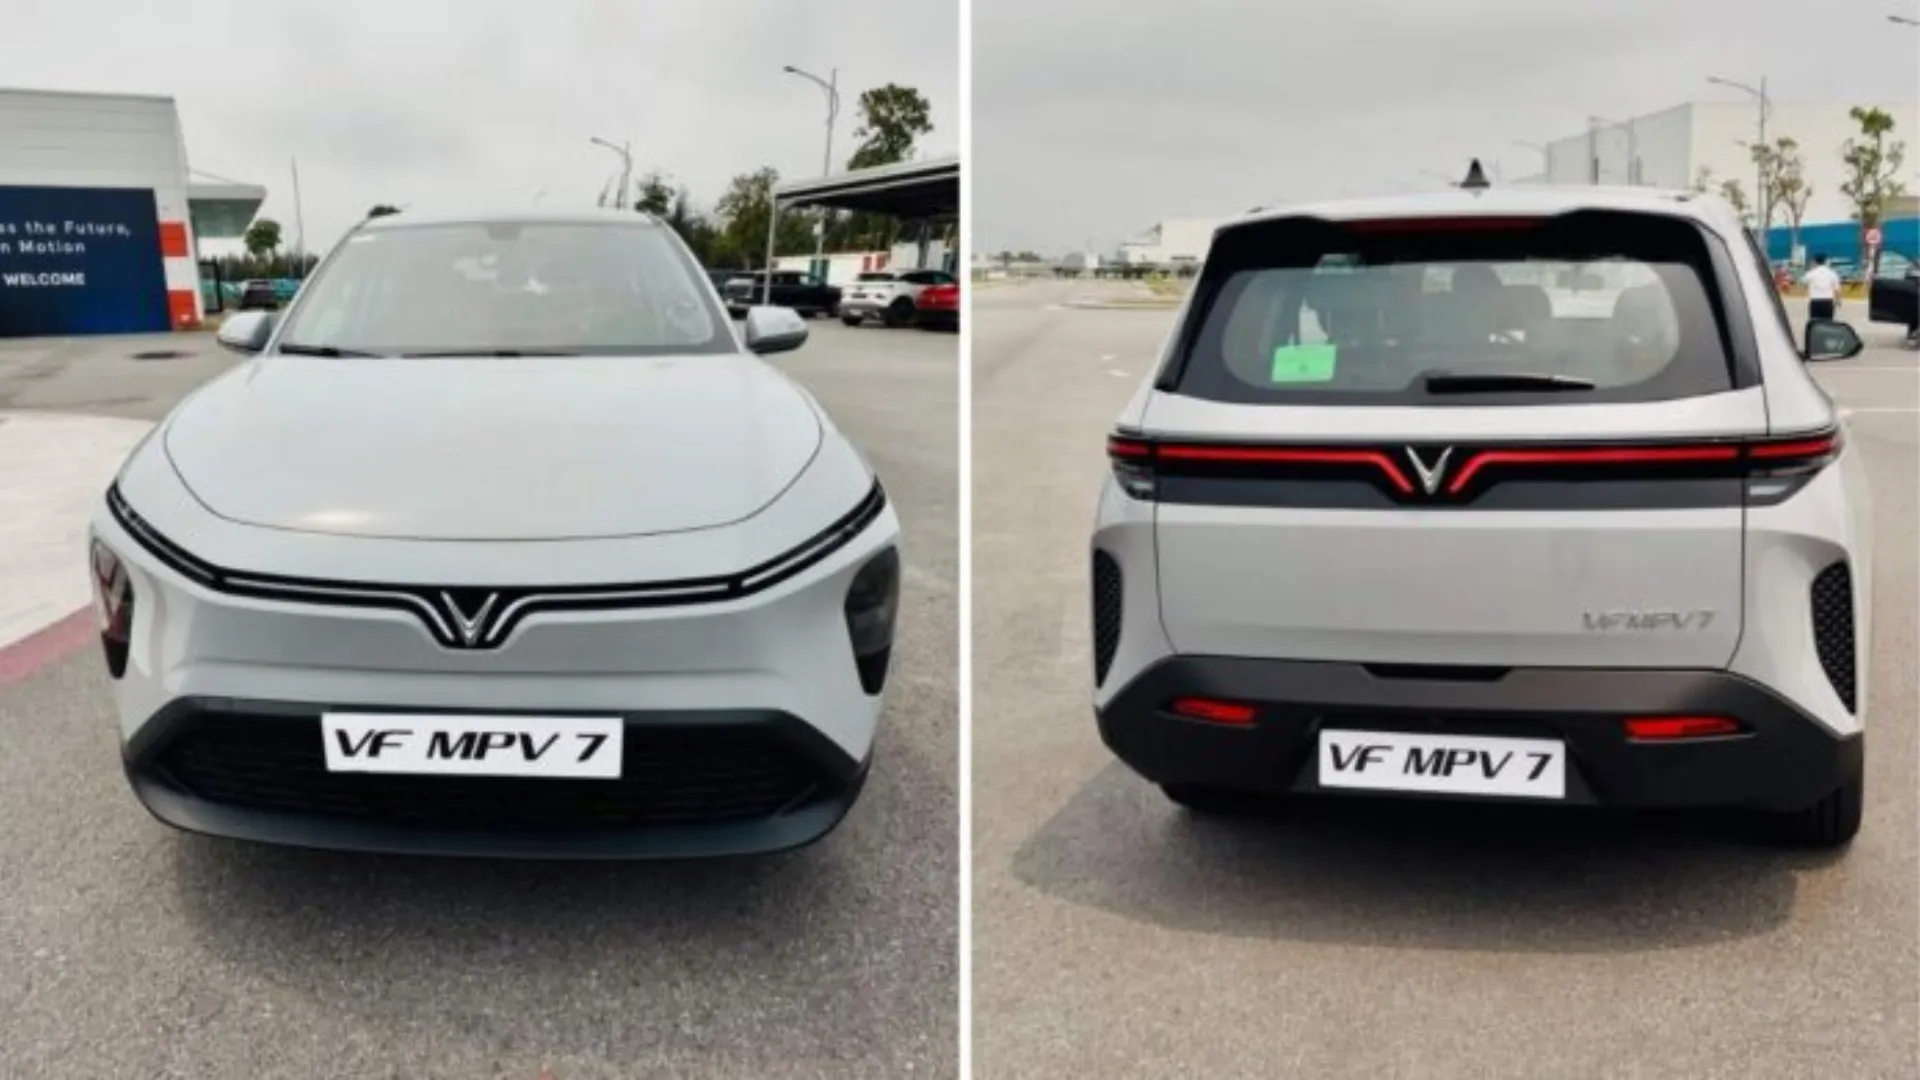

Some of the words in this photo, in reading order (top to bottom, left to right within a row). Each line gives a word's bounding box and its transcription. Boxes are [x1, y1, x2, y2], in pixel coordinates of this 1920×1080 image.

[25, 220, 57, 234] the
[64, 220, 131, 237] Future,
[18, 240, 86, 254] Motion
[3, 273, 86, 286] WELCOME
[335, 729, 414, 757] VF
[426, 731, 560, 761] MPV
[575, 733, 609, 763] 7
[1329, 743, 1393, 773] VF
[1403, 747, 1514, 779] MPV
[1526, 752, 1554, 781] 7
